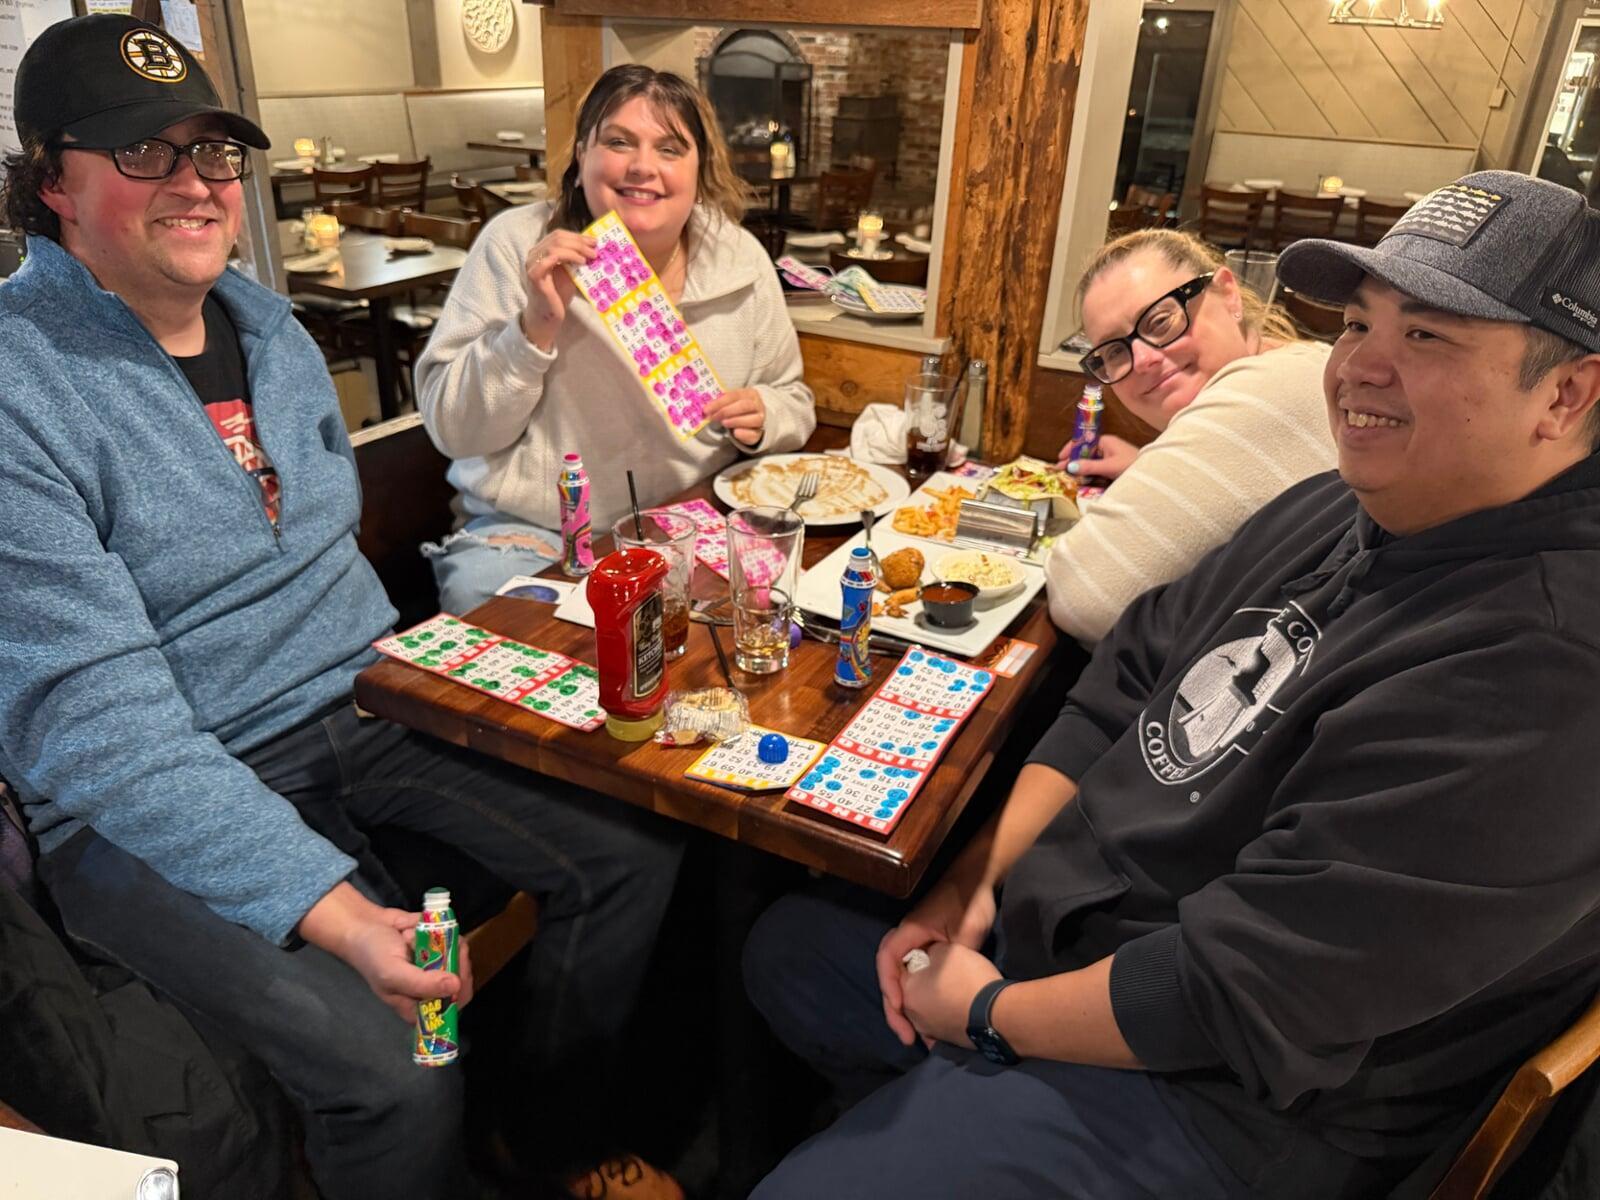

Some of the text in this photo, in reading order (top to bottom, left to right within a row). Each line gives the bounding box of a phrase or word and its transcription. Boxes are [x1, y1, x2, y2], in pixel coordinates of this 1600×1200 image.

[134, 38, 175, 71] B
[1561, 297, 1598, 325] Columbia
[854, 723, 867, 732] 65
[877, 722, 890, 730] 57
[871, 730, 884, 738] 51
[864, 738, 878, 746] 60
[888, 735, 902, 743] 33
[830, 750, 844, 759] 72
[1146, 721, 1191, 780] COFFEE
[797, 752, 809, 760] 12
[848, 756, 862, 765] 50
[720, 764, 735, 772] 59
[867, 762, 880, 770] 41
[841, 764, 911, 789] 10 18 47
[846, 788, 859, 797] 36
[871, 784, 886, 793] 28
[820, 790, 834, 798] 55
[838, 797, 852, 806] 40
[864, 794, 878, 804] 23
[858, 804, 872, 813] 27
[420, 999, 442, 1016] DAB
